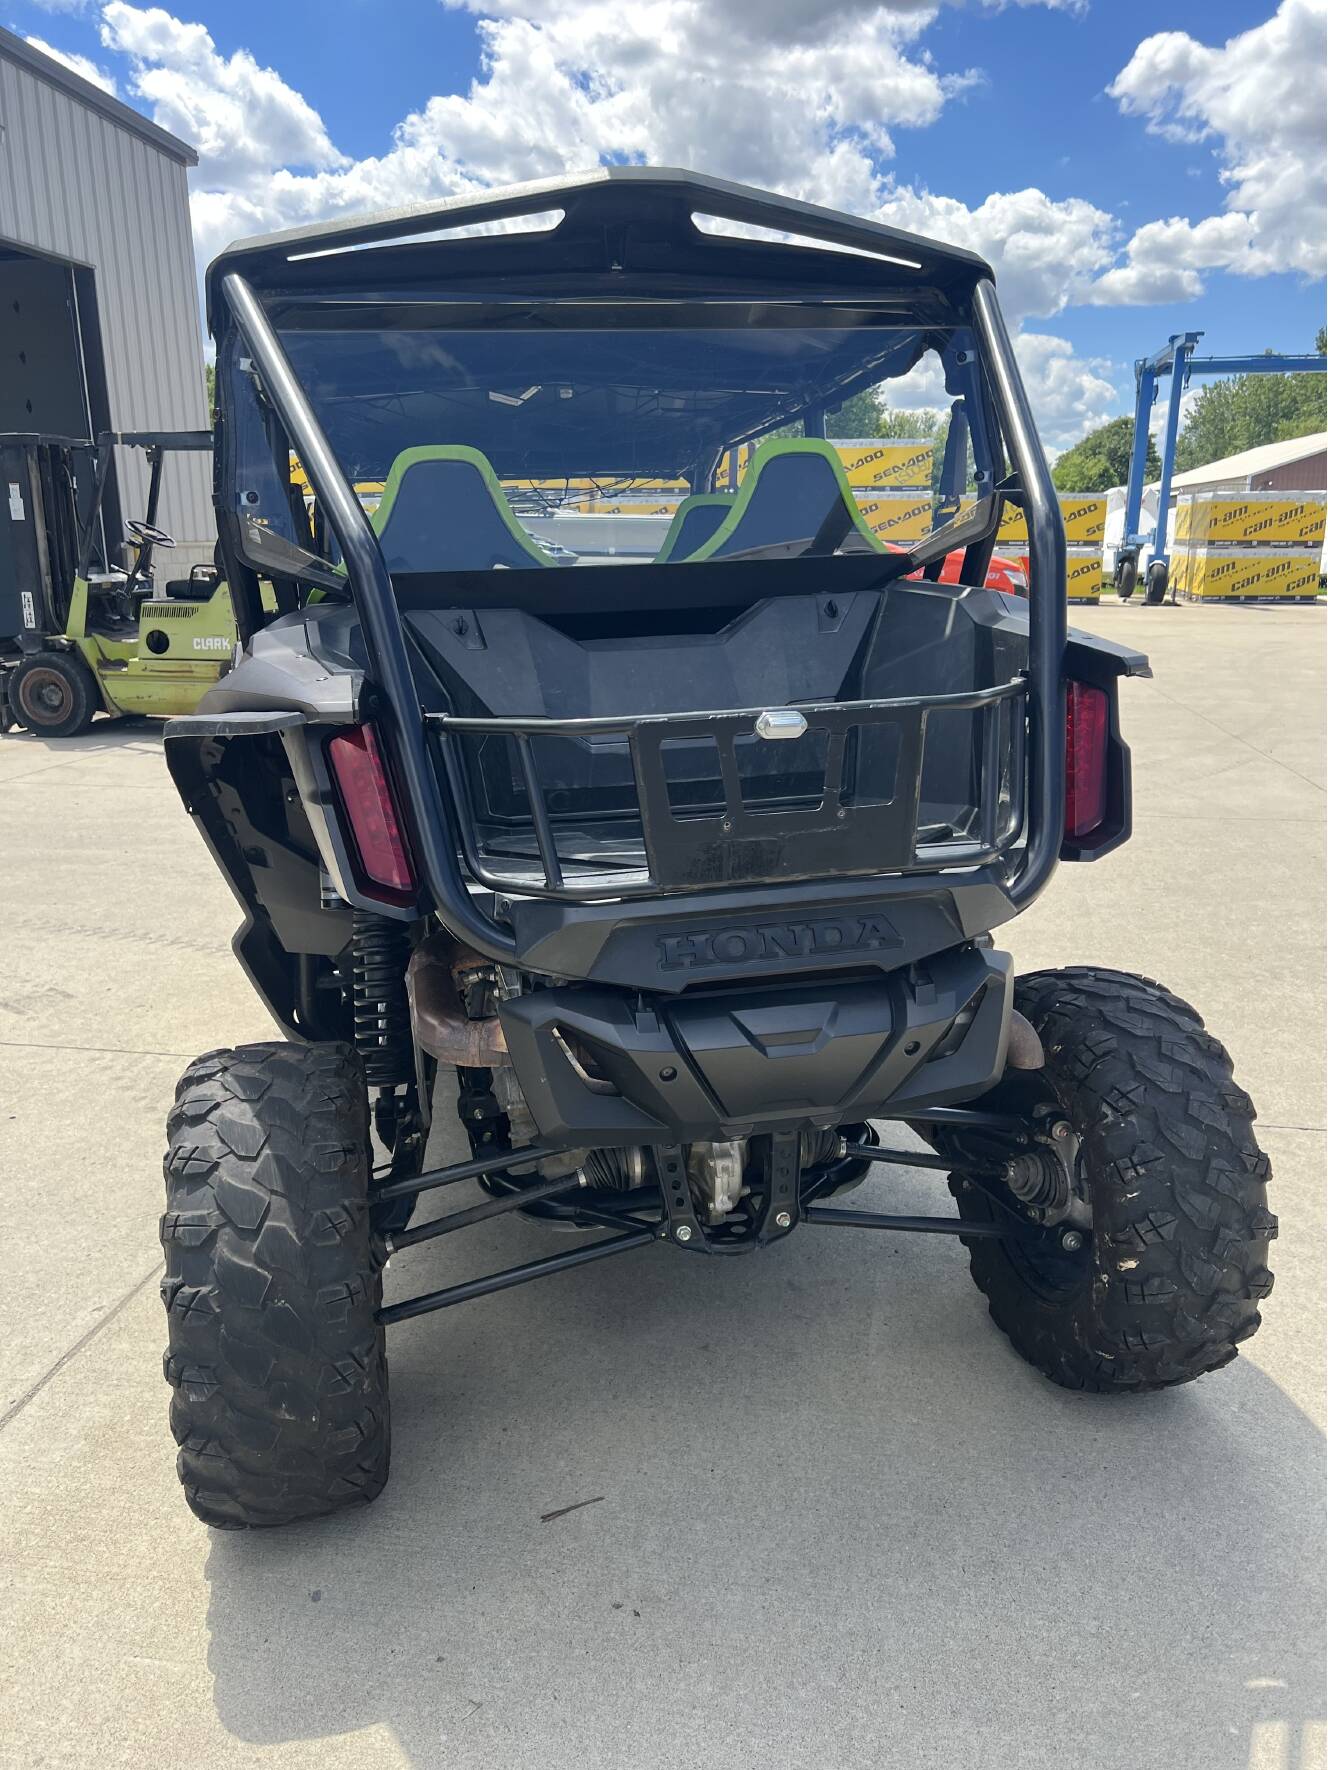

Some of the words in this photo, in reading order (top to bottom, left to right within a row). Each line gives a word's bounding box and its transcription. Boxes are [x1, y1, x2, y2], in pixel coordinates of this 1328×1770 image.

[1243, 505, 1305, 537] can-am
[1231, 561, 1292, 593] can-am
[193, 638, 231, 650] CLARK
[656, 913, 904, 971] HONDA
